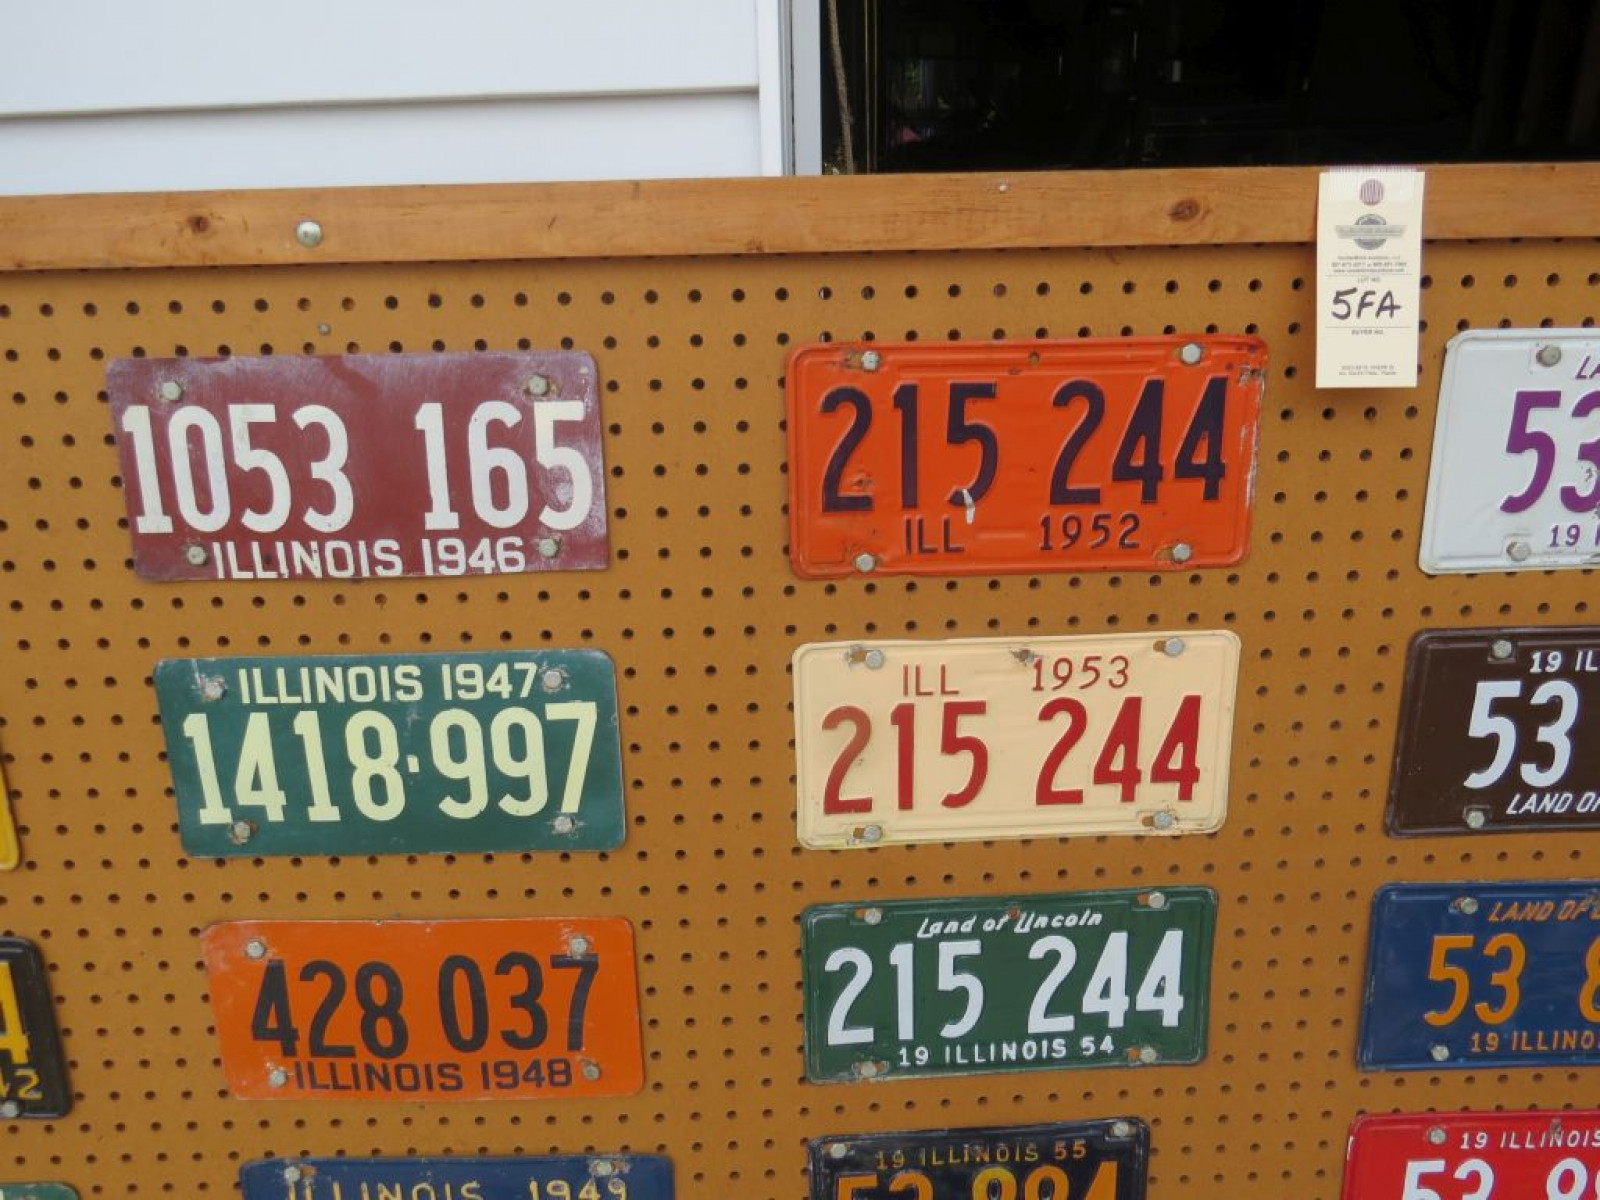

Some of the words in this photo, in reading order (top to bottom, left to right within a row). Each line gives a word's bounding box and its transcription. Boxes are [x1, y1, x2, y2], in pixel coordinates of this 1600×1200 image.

[1331, 287, 1402, 320] 5FA
[819, 381, 998, 513] 215
[1049, 377, 1228, 506] 244
[122, 403, 354, 533] 1053
[415, 401, 592, 531] 165
[905, 518, 965, 554] ILL
[1040, 513, 1140, 551] 1952
[1549, 524, 1580, 547] 19
[213, 539, 402, 579] ILLINOIS
[422, 536, 526, 577] 1946
[903, 664, 959, 697] ILL
[1032, 655, 1129, 692] 1953
[1530, 651, 1561, 673] 19
[239, 665, 423, 704] ILLINOIS
[441, 662, 537, 701] 1947
[1463, 680, 1579, 789] 53
[822, 701, 988, 815] 215
[1036, 695, 1202, 805] 244
[1506, 793, 1573, 814] LAND
[917, 915, 977, 938] Land
[982, 912, 1010, 932] of
[1014, 908, 1103, 934] Lincoln
[1488, 902, 1555, 921] LAND
[824, 940, 984, 1046] 215
[1028, 928, 1184, 1034] 244
[1424, 932, 1526, 1026] 53
[251, 958, 408, 1059] 428
[438, 951, 599, 1053] 037
[899, 1046, 929, 1067] 19
[945, 1038, 1067, 1064] ILLINOIS
[1081, 1035, 1114, 1057] 54
[1471, 1032, 1499, 1052] 19
[1512, 1030, 1600, 1051] ILLINO
[294, 1061, 463, 1092] ILLINOIS
[481, 1058, 572, 1090] 1948
[875, 1150, 905, 1170] 19
[920, 1142, 1039, 1166] ILLINOIS
[1054, 1138, 1087, 1160] 55
[1460, 1132, 1488, 1149] 19
